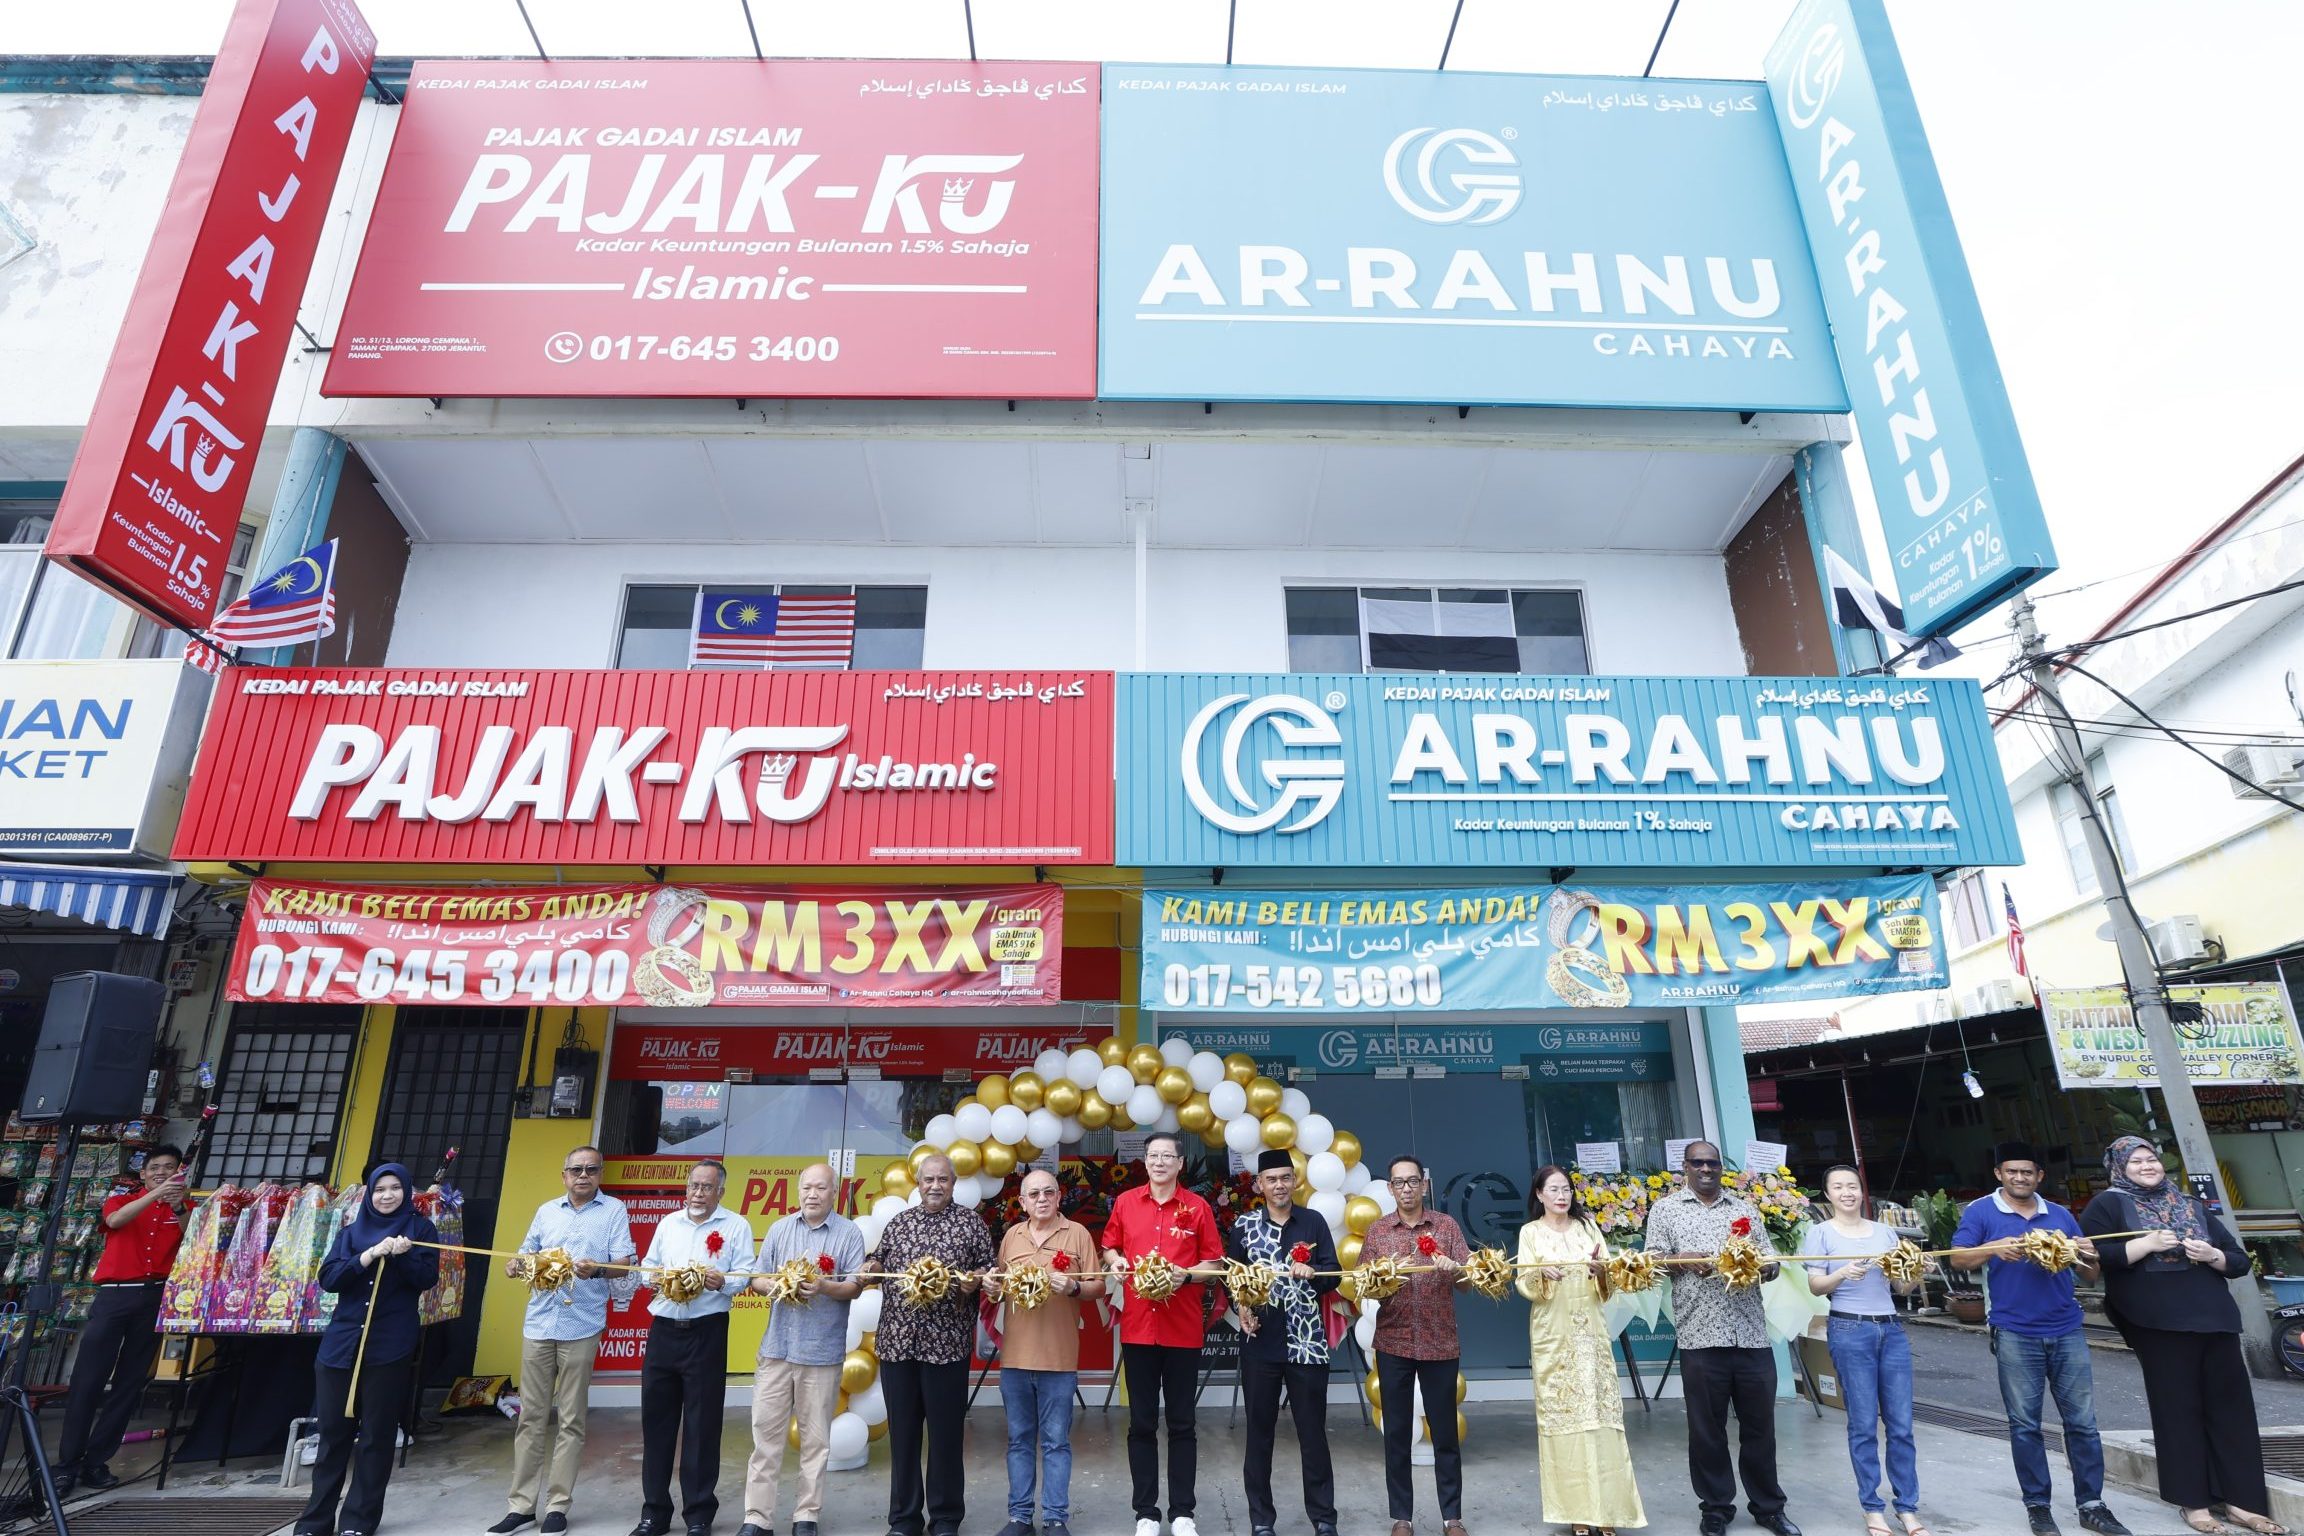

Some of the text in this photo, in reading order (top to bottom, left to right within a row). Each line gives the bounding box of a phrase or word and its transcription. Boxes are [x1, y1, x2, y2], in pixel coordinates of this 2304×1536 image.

[416, 80, 648, 89] KEDAI PAJAK GADAI ISLAM
[1118, 80, 1348, 94] KEDAI PAJAK GADAI ISLAM
[483, 127, 803, 147] PAJAK GADAI ISLAM
[574, 238, 1030, 257] Kadar Keuntungan Bulanan 1.5% Sahaja
[631, 265, 815, 301] Islamic
[1138, 244, 1783, 319] AR-RAHNU
[589, 334, 840, 362] 017-645 3400
[1592, 332, 1795, 361] CAHAYA
[148, 478, 206, 535] Islamic
[112, 511, 172, 558] Keuntungan
[145, 521, 175, 546] Kadar
[1900, 497, 1987, 568] CAHAYA
[127, 537, 168, 570] Bulanan
[1929, 549, 1956, 575] Kadar
[1961, 522, 2001, 581] 1%
[166, 579, 206, 611] Sahaja
[1909, 564, 1960, 605] Keuntungan
[1928, 579, 1964, 609] Bulanan
[242, 679, 530, 698] KEDAI PAJAK GADAI ISLAM
[1384, 687, 1610, 702] KEDAI PAJAK GADAI ISLAM
[1389, 713, 1946, 787] AR-RAHNU
[838, 753, 998, 792] Islamic
[1454, 811, 1713, 834] Kadar Keuntungan Bulanan 1% Sahaja
[1780, 804, 1961, 833] CAHAYA
[44, 832, 112, 843] (CA0089677-P)
[262, 888, 650, 921] KAMI BELI EMAS ANDA!
[1160, 895, 1540, 926] KAMI BELI EMAS ANDA!
[257, 919, 319, 935] HUBUNGI
[699, 899, 990, 974] RM 3XX
[995, 930, 1037, 939] Sah Untuk
[1161, 928, 1223, 944] HUBUNGI
[996, 940, 1036, 948] EMAS 916
[1599, 901, 1732, 976] RM
[1002, 949, 1031, 960] Sahaja
[244, 943, 469, 1001] 017-645
[479, 948, 631, 1002] 3400
[738, 985, 828, 994] PAJAK GADAI ISLAM
[1163, 963, 1442, 1008] 017-542 5680
[1661, 984, 1742, 998] AR-RAHNU
[890, 1042, 925, 1051] Islamic
[1192, 1034, 1271, 1046] AR-RAHNU
[1365, 1037, 1494, 1055] AR-RAHNU
[1566, 1031, 1641, 1042] AR-RAHNU
[975, 1037, 1088, 1059] PAJAK-K
[2082, 1054, 2096, 1062] BY
[2098, 1054, 2137, 1062] NURUL
[667, 1084, 721, 1097] OPEN
[622, 1164, 677, 1180] KADAR KEUNTUNGAN
[749, 1168, 772, 1176] PAJAK
[639, 1199, 681, 1210] MENERIMA
[608, 1328, 635, 1339] KADAR
[599, 1340, 635, 1358] YANG
